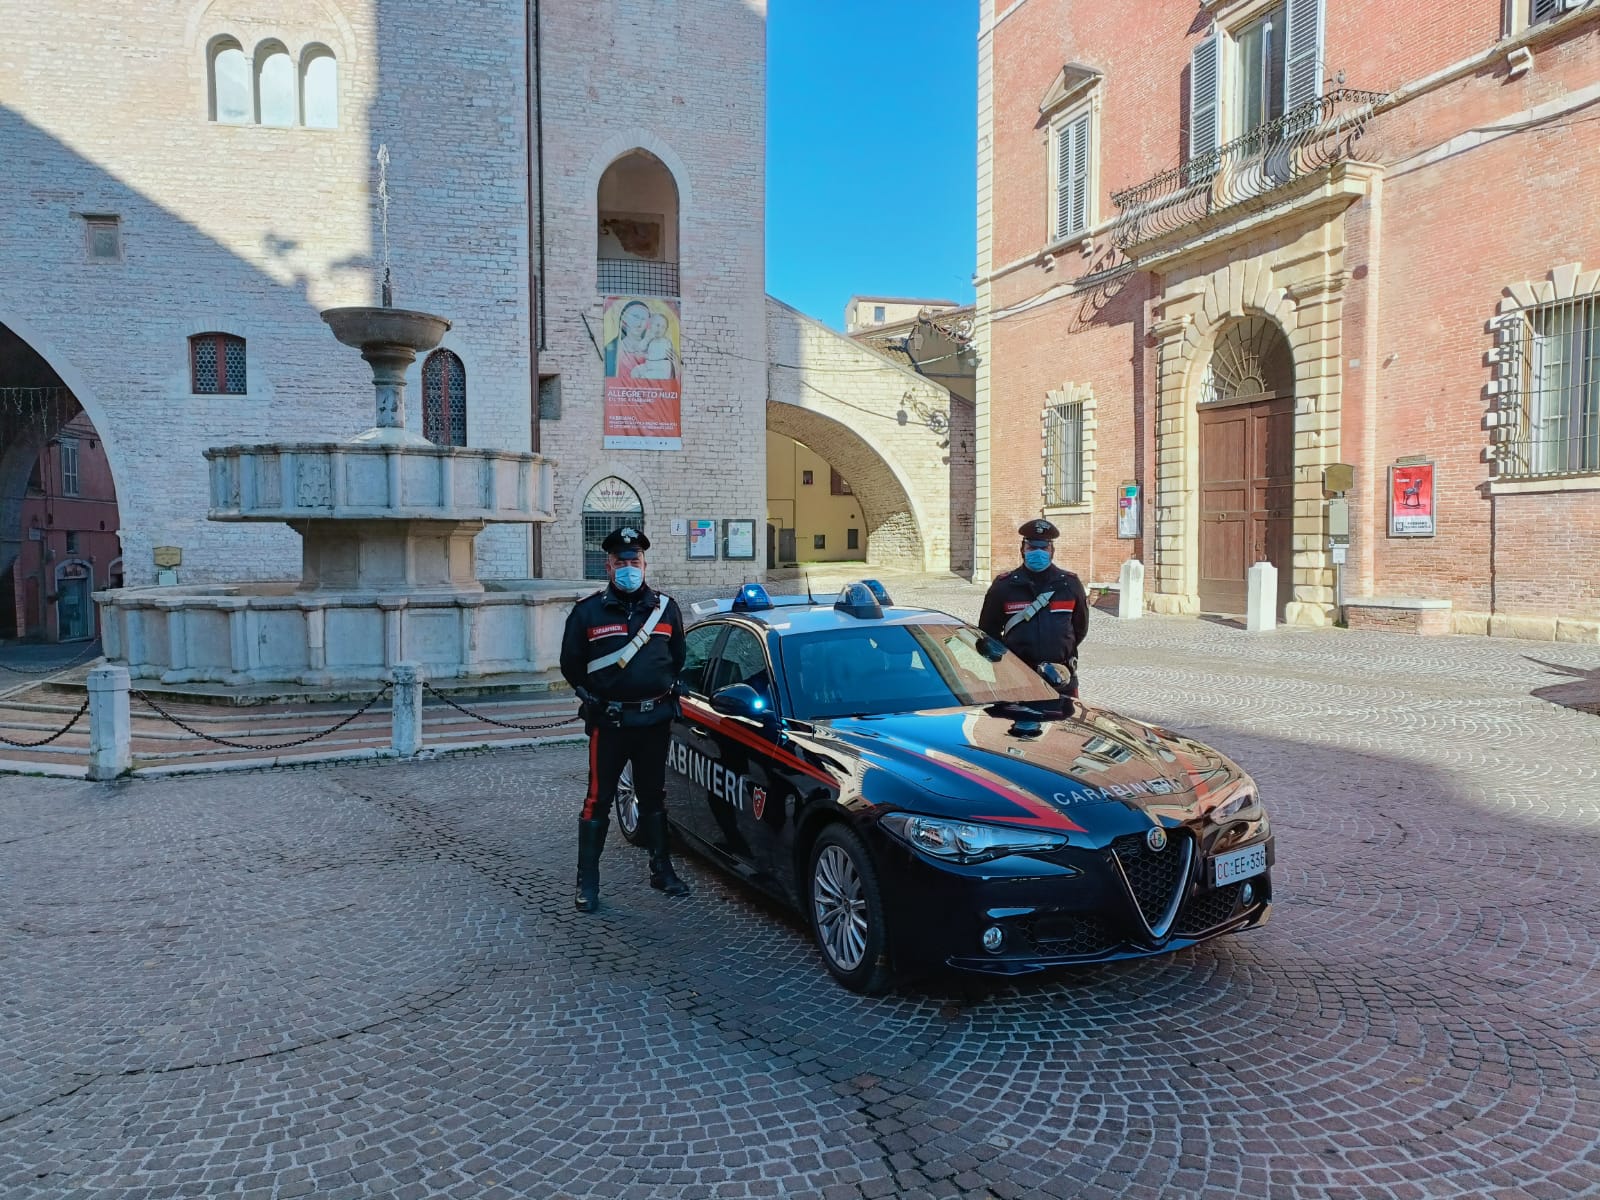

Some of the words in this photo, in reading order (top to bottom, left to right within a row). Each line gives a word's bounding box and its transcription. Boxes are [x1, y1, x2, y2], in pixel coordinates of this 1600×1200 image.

[607, 390, 658, 398] ALLEGRETTO
[659, 391, 678, 399] NUZI
[665, 739, 744, 811] ABINIERI
[1217, 861, 1230, 880] CC
